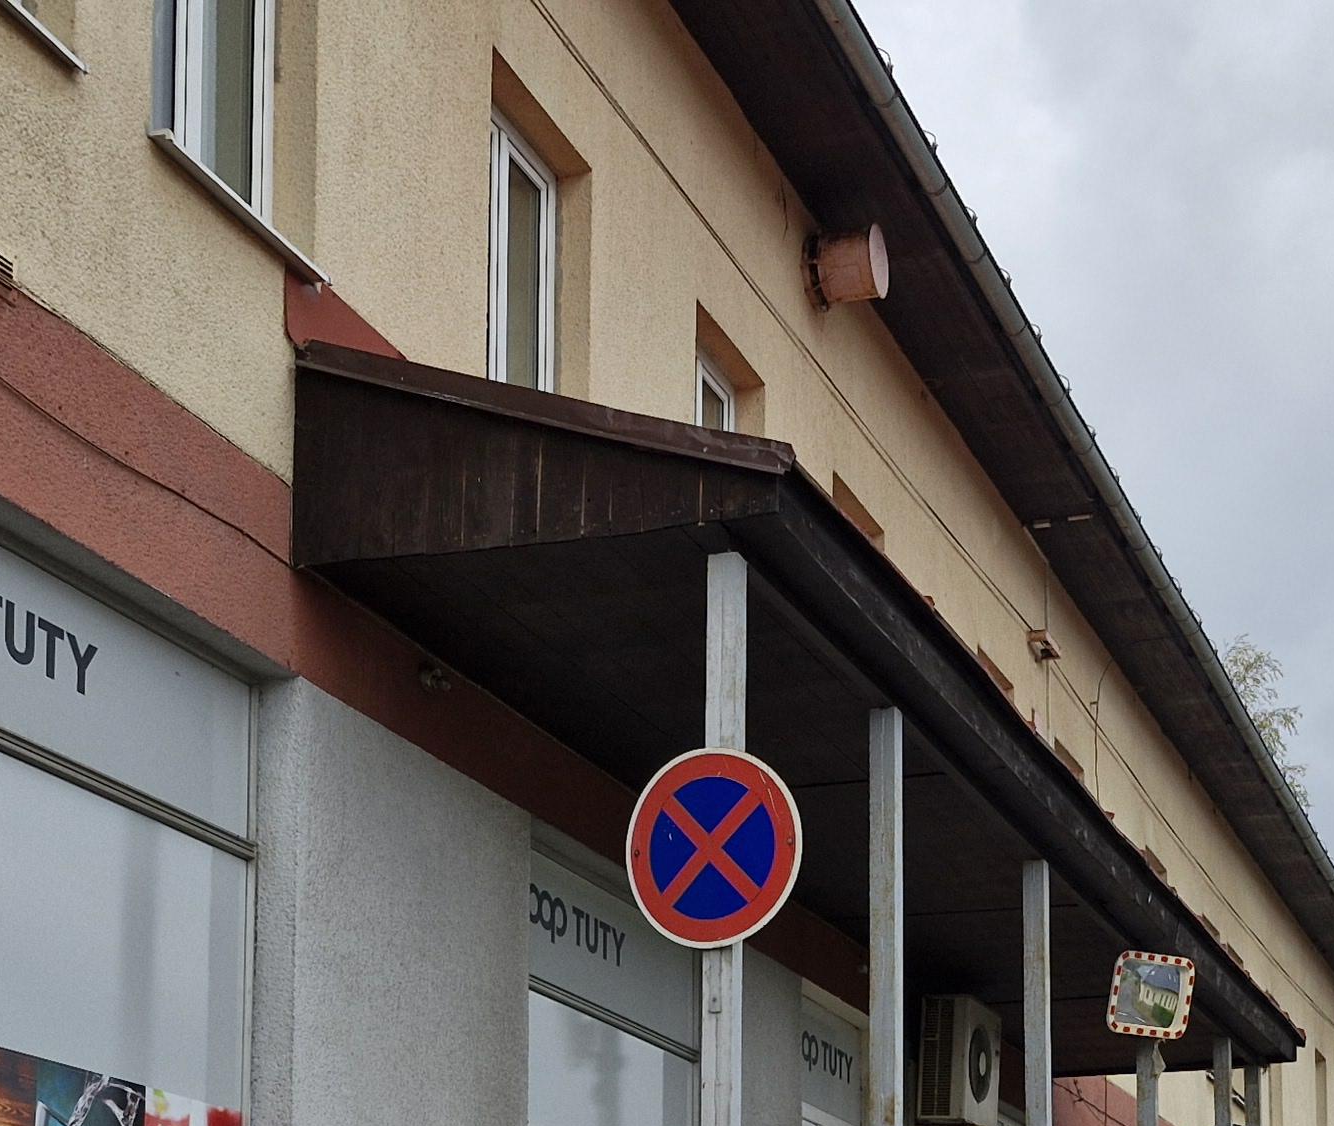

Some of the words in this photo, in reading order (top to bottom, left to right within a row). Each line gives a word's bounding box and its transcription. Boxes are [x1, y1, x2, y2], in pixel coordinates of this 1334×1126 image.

[529, 883, 568, 944] oop
[571, 905, 626, 967] TUTY
[801, 1030, 819, 1072] op
[821, 1040, 853, 1085] TUTY
